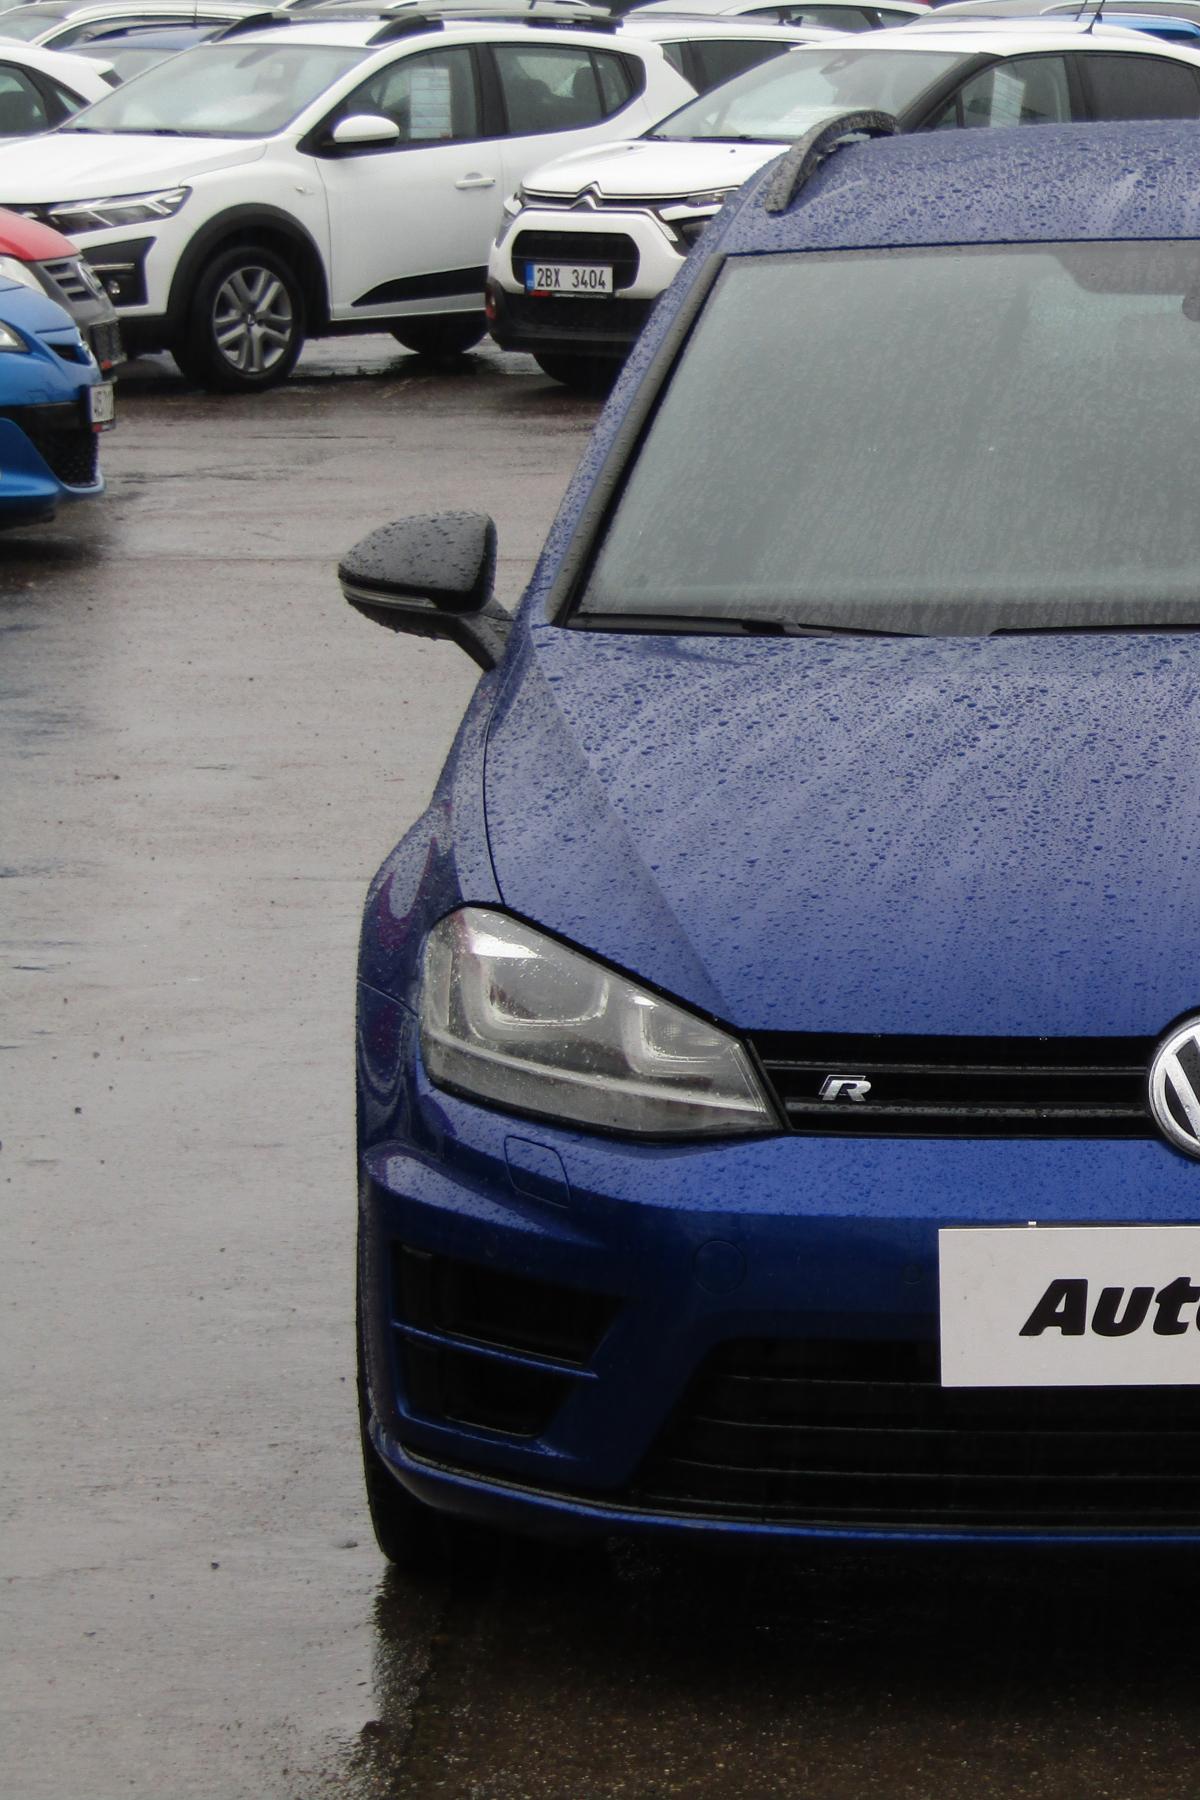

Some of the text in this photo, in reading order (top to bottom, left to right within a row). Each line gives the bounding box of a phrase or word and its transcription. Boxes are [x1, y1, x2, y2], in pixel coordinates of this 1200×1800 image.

[537, 268, 606, 288] 2BX 3404
[819, 1075, 871, 1101] R
